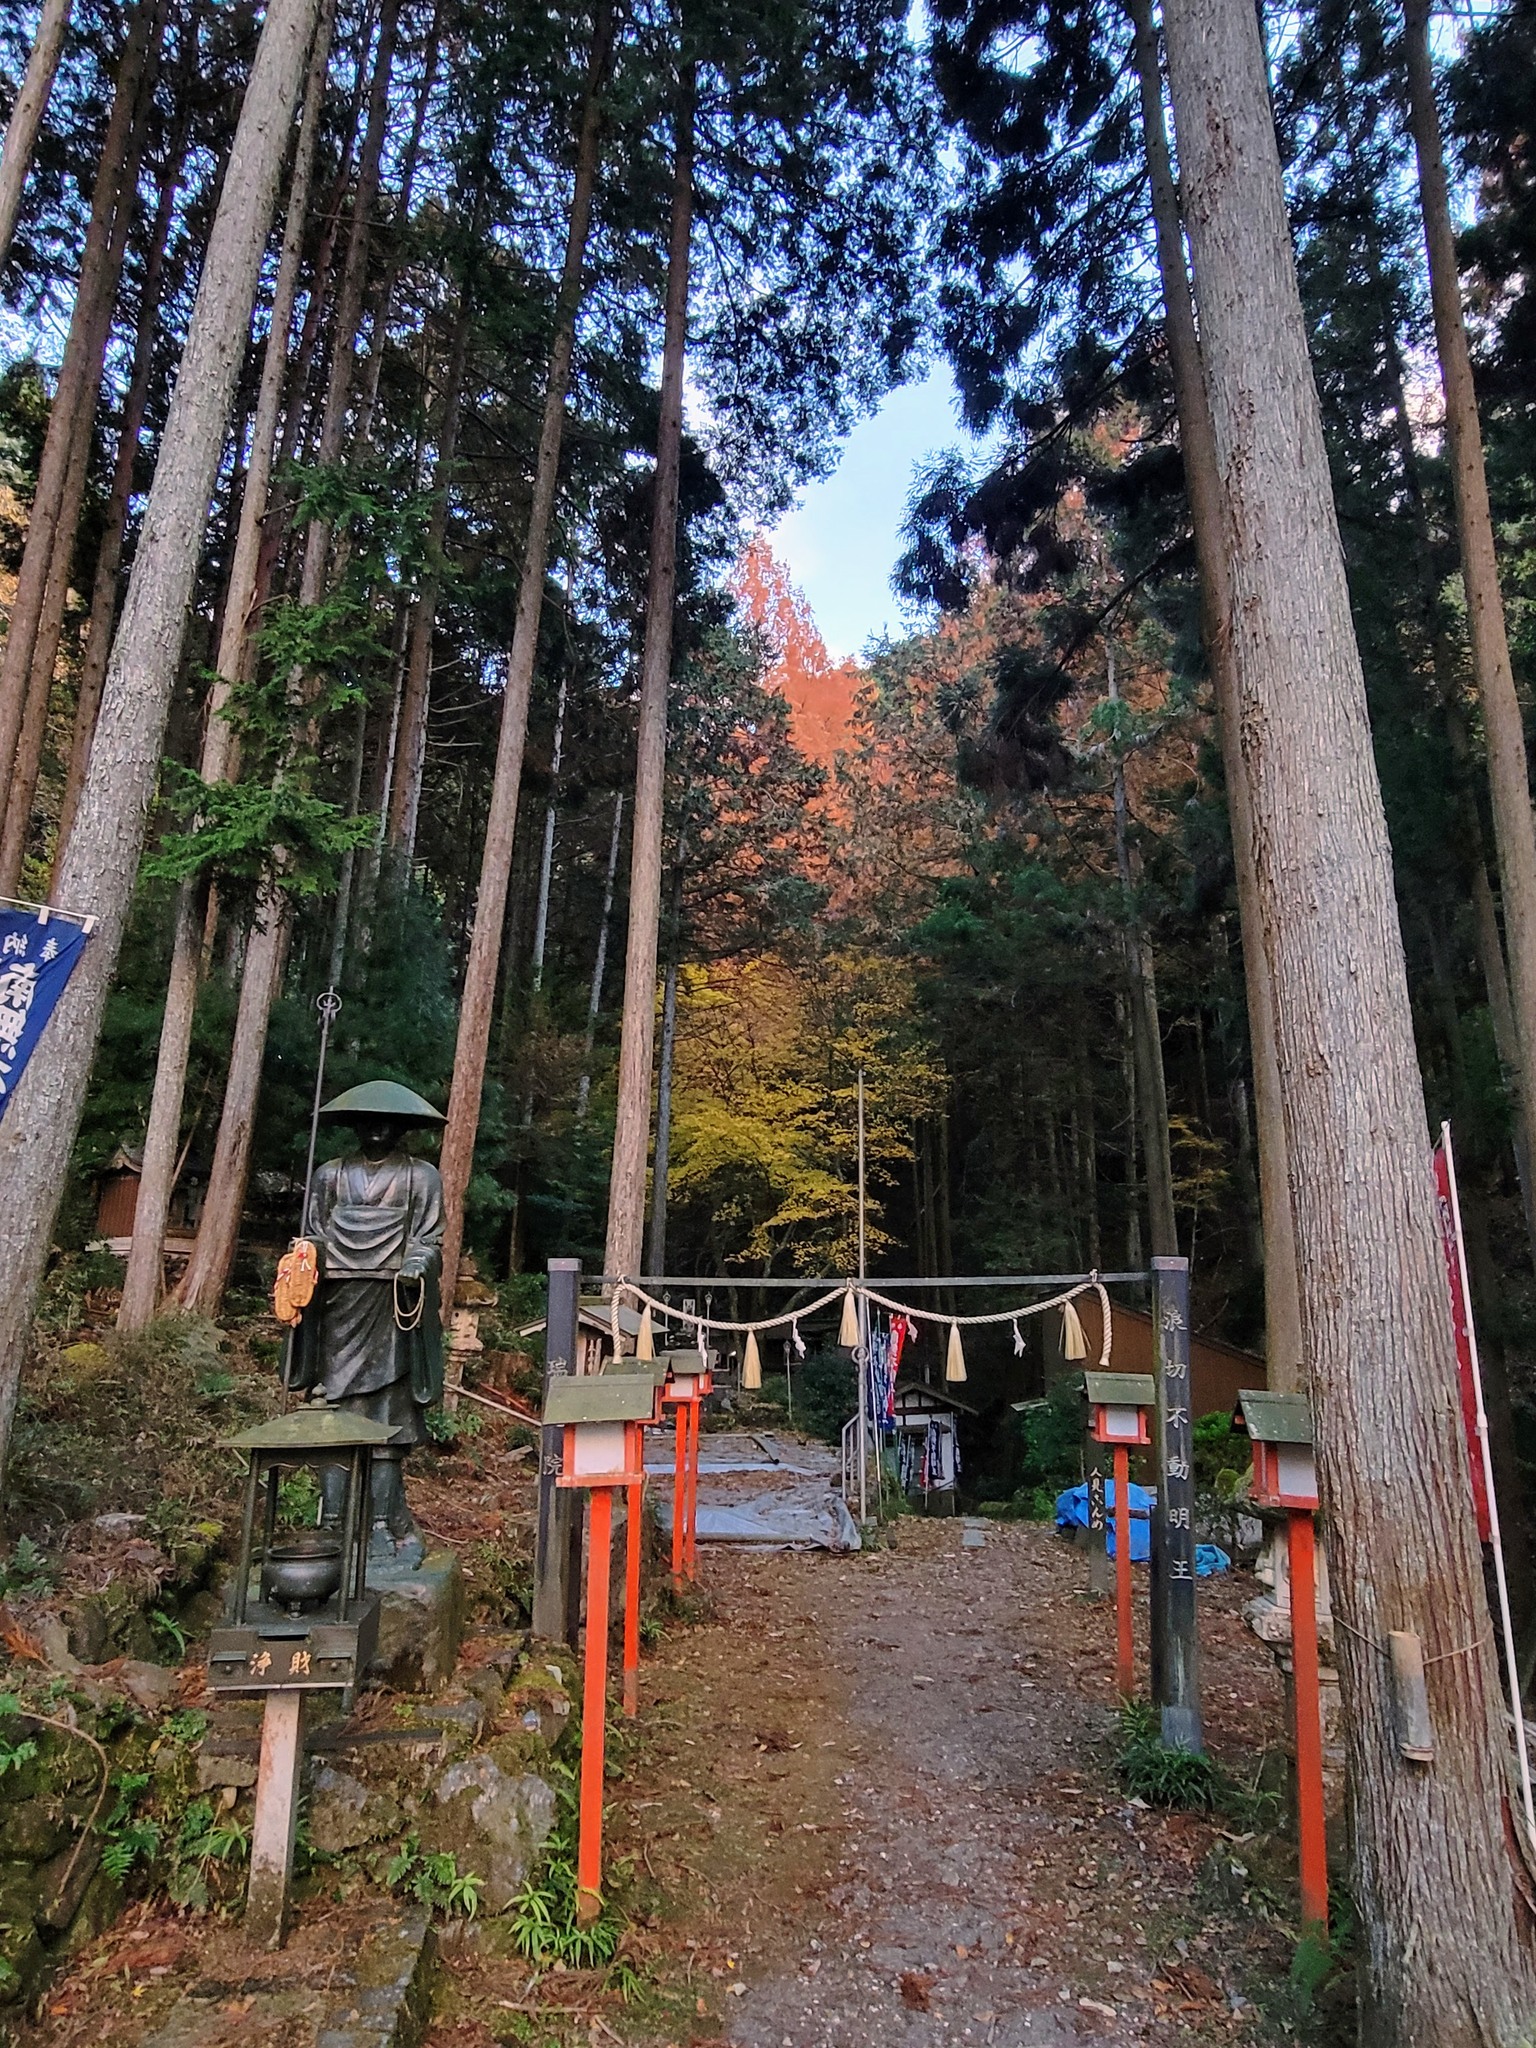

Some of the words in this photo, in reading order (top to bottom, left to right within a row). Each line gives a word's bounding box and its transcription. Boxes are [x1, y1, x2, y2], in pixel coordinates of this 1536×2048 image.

[542, 1356, 568, 1477] 瑞院
[1162, 1309, 1193, 1581] 浪切不動明王
[249, 1650, 312, 1677] 浄財
